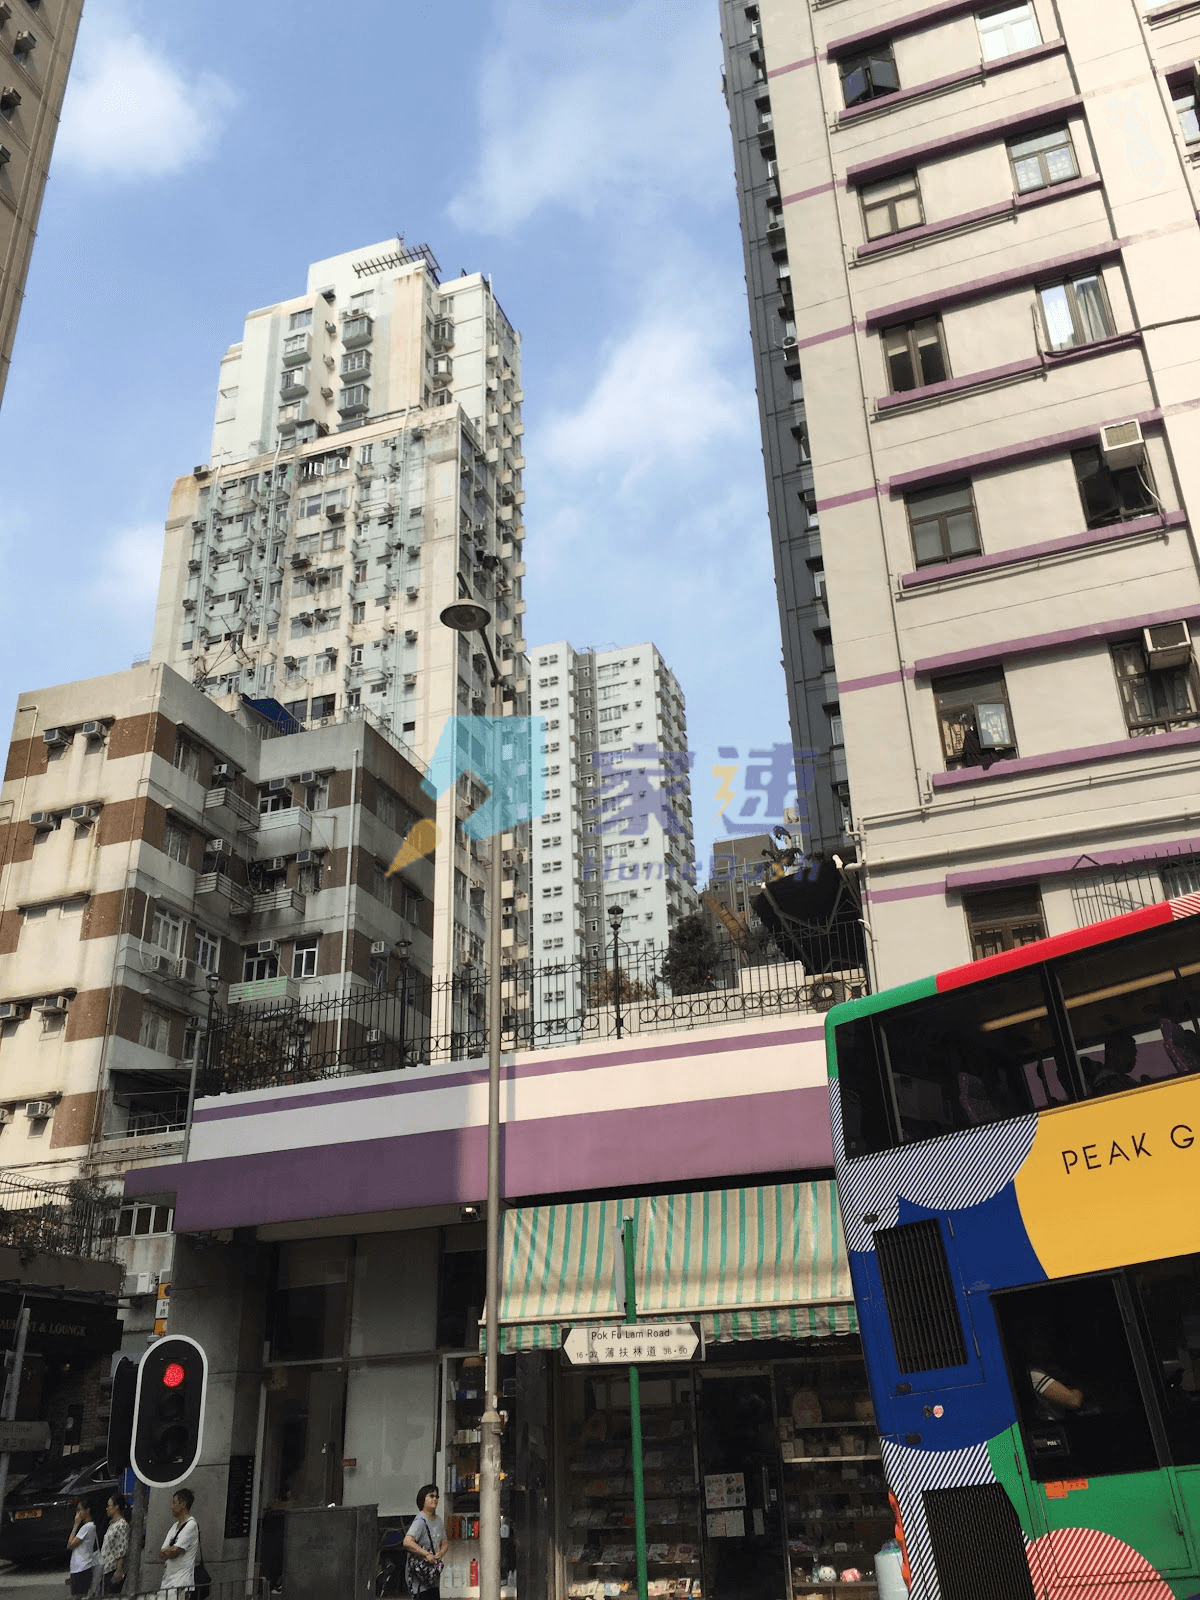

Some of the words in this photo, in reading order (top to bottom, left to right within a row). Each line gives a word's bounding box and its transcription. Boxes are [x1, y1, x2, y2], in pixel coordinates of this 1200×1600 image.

[1061, 1132, 1152, 1175] PEAK
[1170, 1124, 1195, 1149] G
[591, 1331, 608, 1341] Pok
[611, 1330, 622, 1340] Fu
[625, 1330, 644, 1339] Lam
[647, 1328, 670, 1338] Road
[605, 1346, 657, 1359] 薄扶林道
